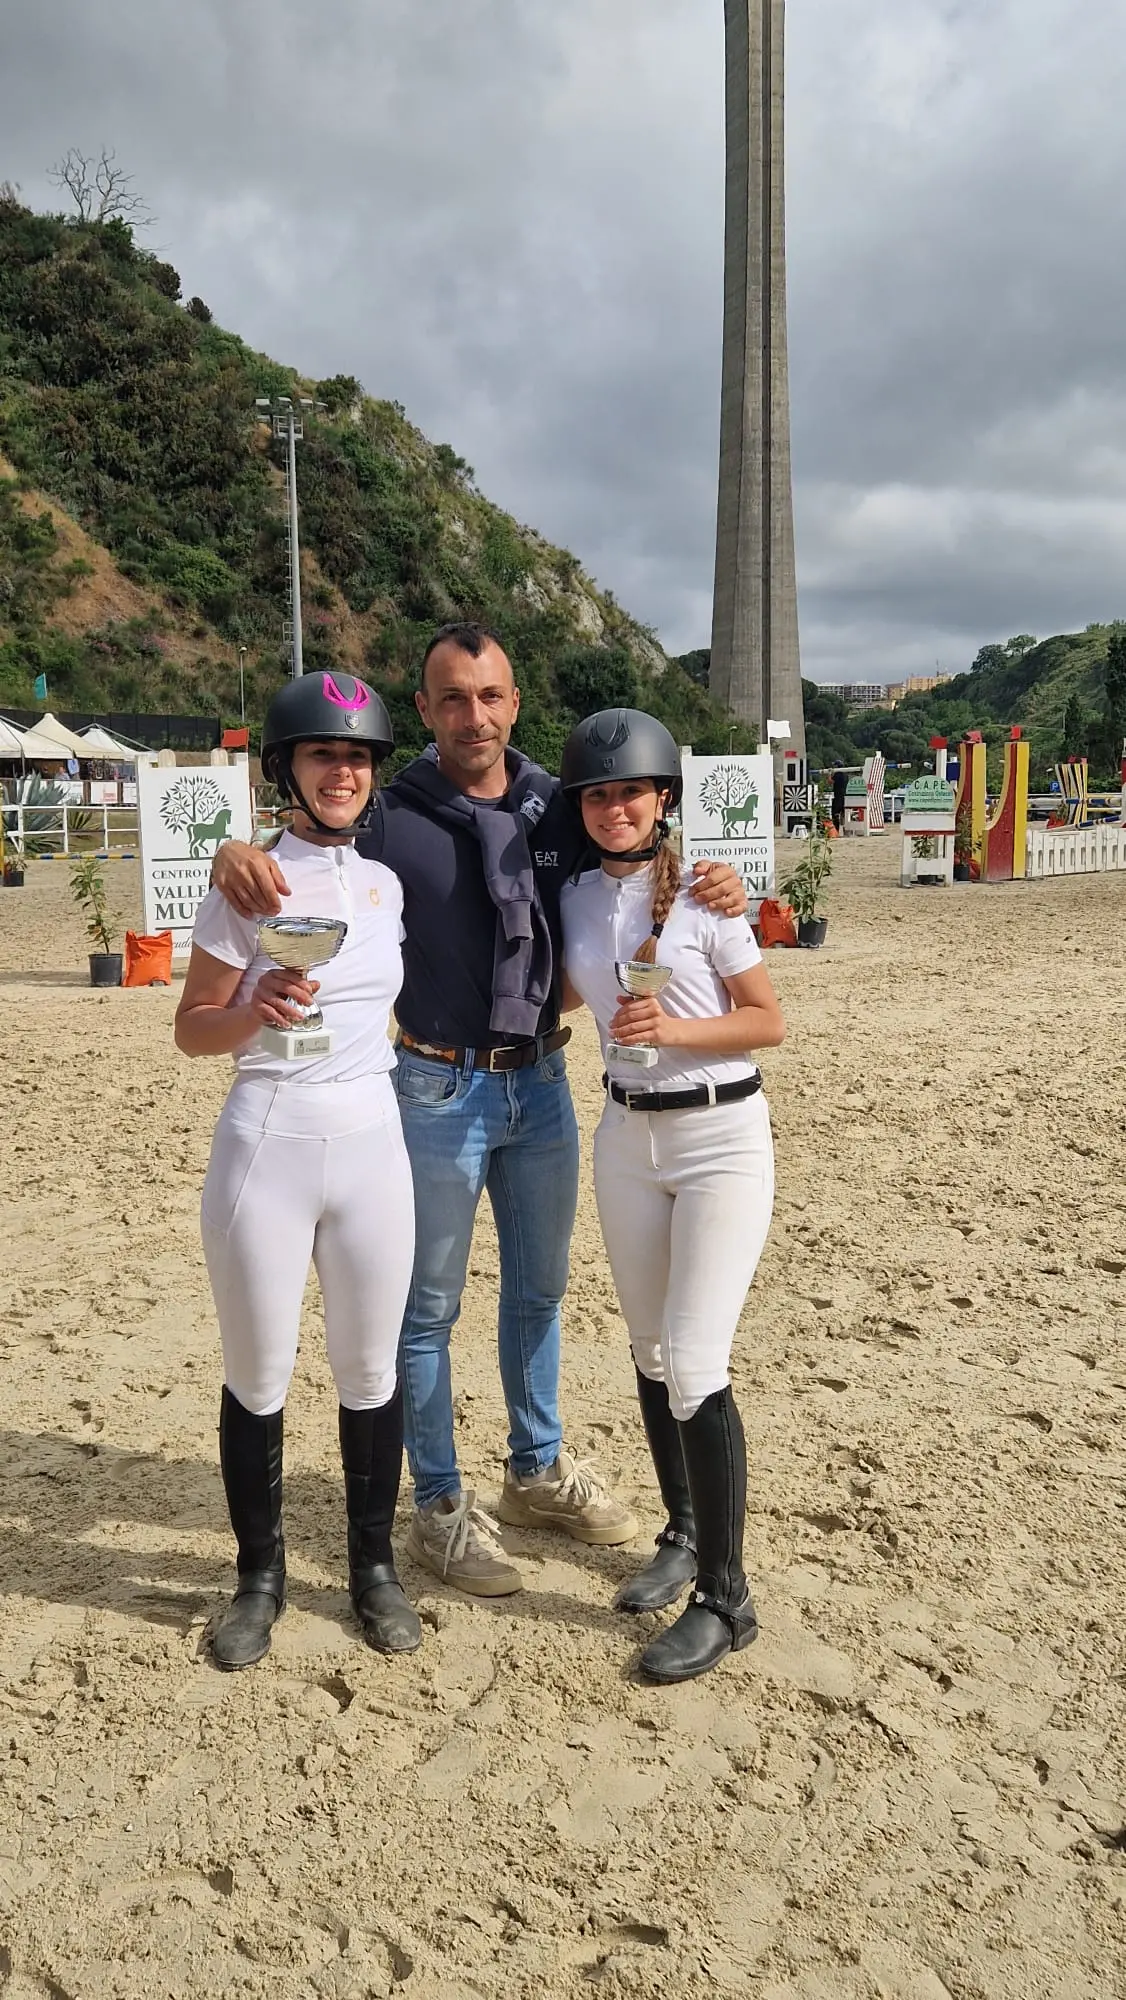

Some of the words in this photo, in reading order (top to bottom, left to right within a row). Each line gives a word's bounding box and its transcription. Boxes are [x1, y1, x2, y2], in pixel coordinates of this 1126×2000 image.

[1052, 782, 1058, 790] P
[534, 851, 559, 863] EA7
[690, 847, 732, 857] CENTRO
[734, 846, 768, 856] IPPICO
[743, 861, 768, 874] DEI
[152, 868, 202, 880] CENTRO
[153, 884, 207, 899] VALLE
